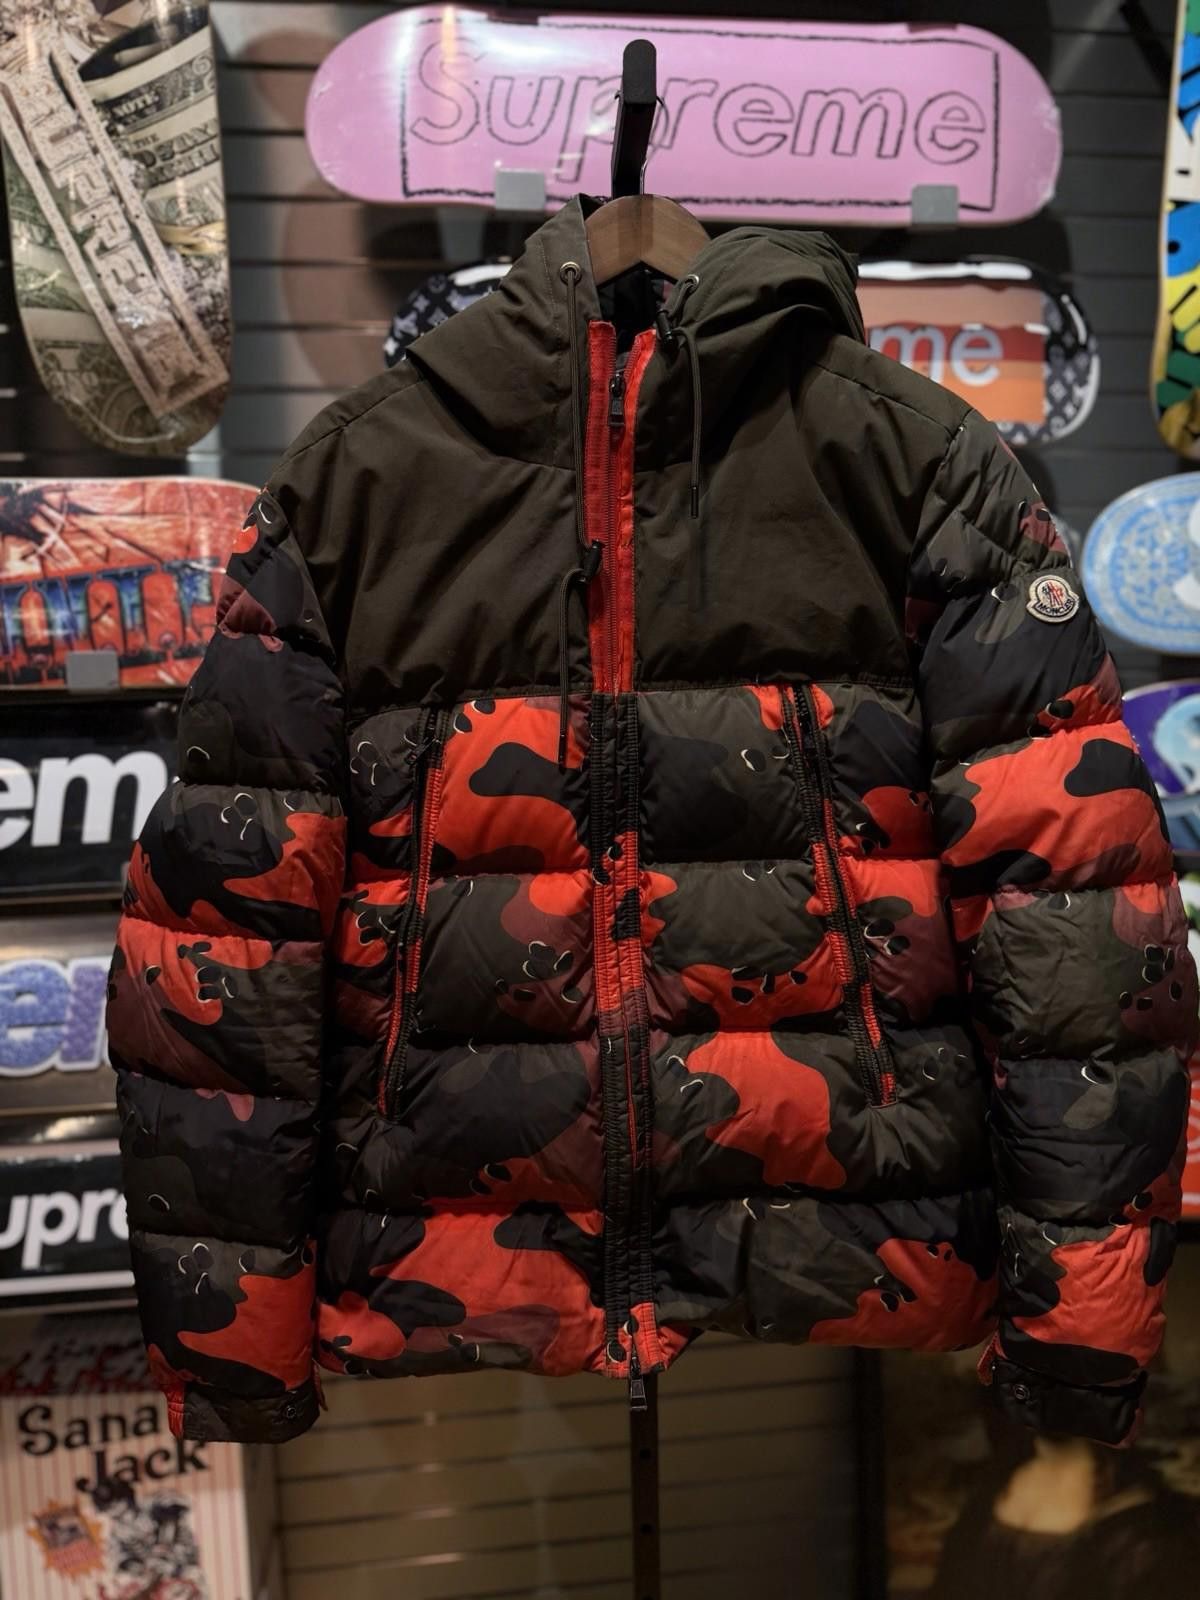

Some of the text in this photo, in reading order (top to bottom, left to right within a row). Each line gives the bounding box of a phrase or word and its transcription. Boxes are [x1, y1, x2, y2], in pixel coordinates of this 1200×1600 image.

[410, 37, 988, 183] Supreme
[18, 1403, 160, 1456] Sana
[74, 1434, 208, 1502] Jack
